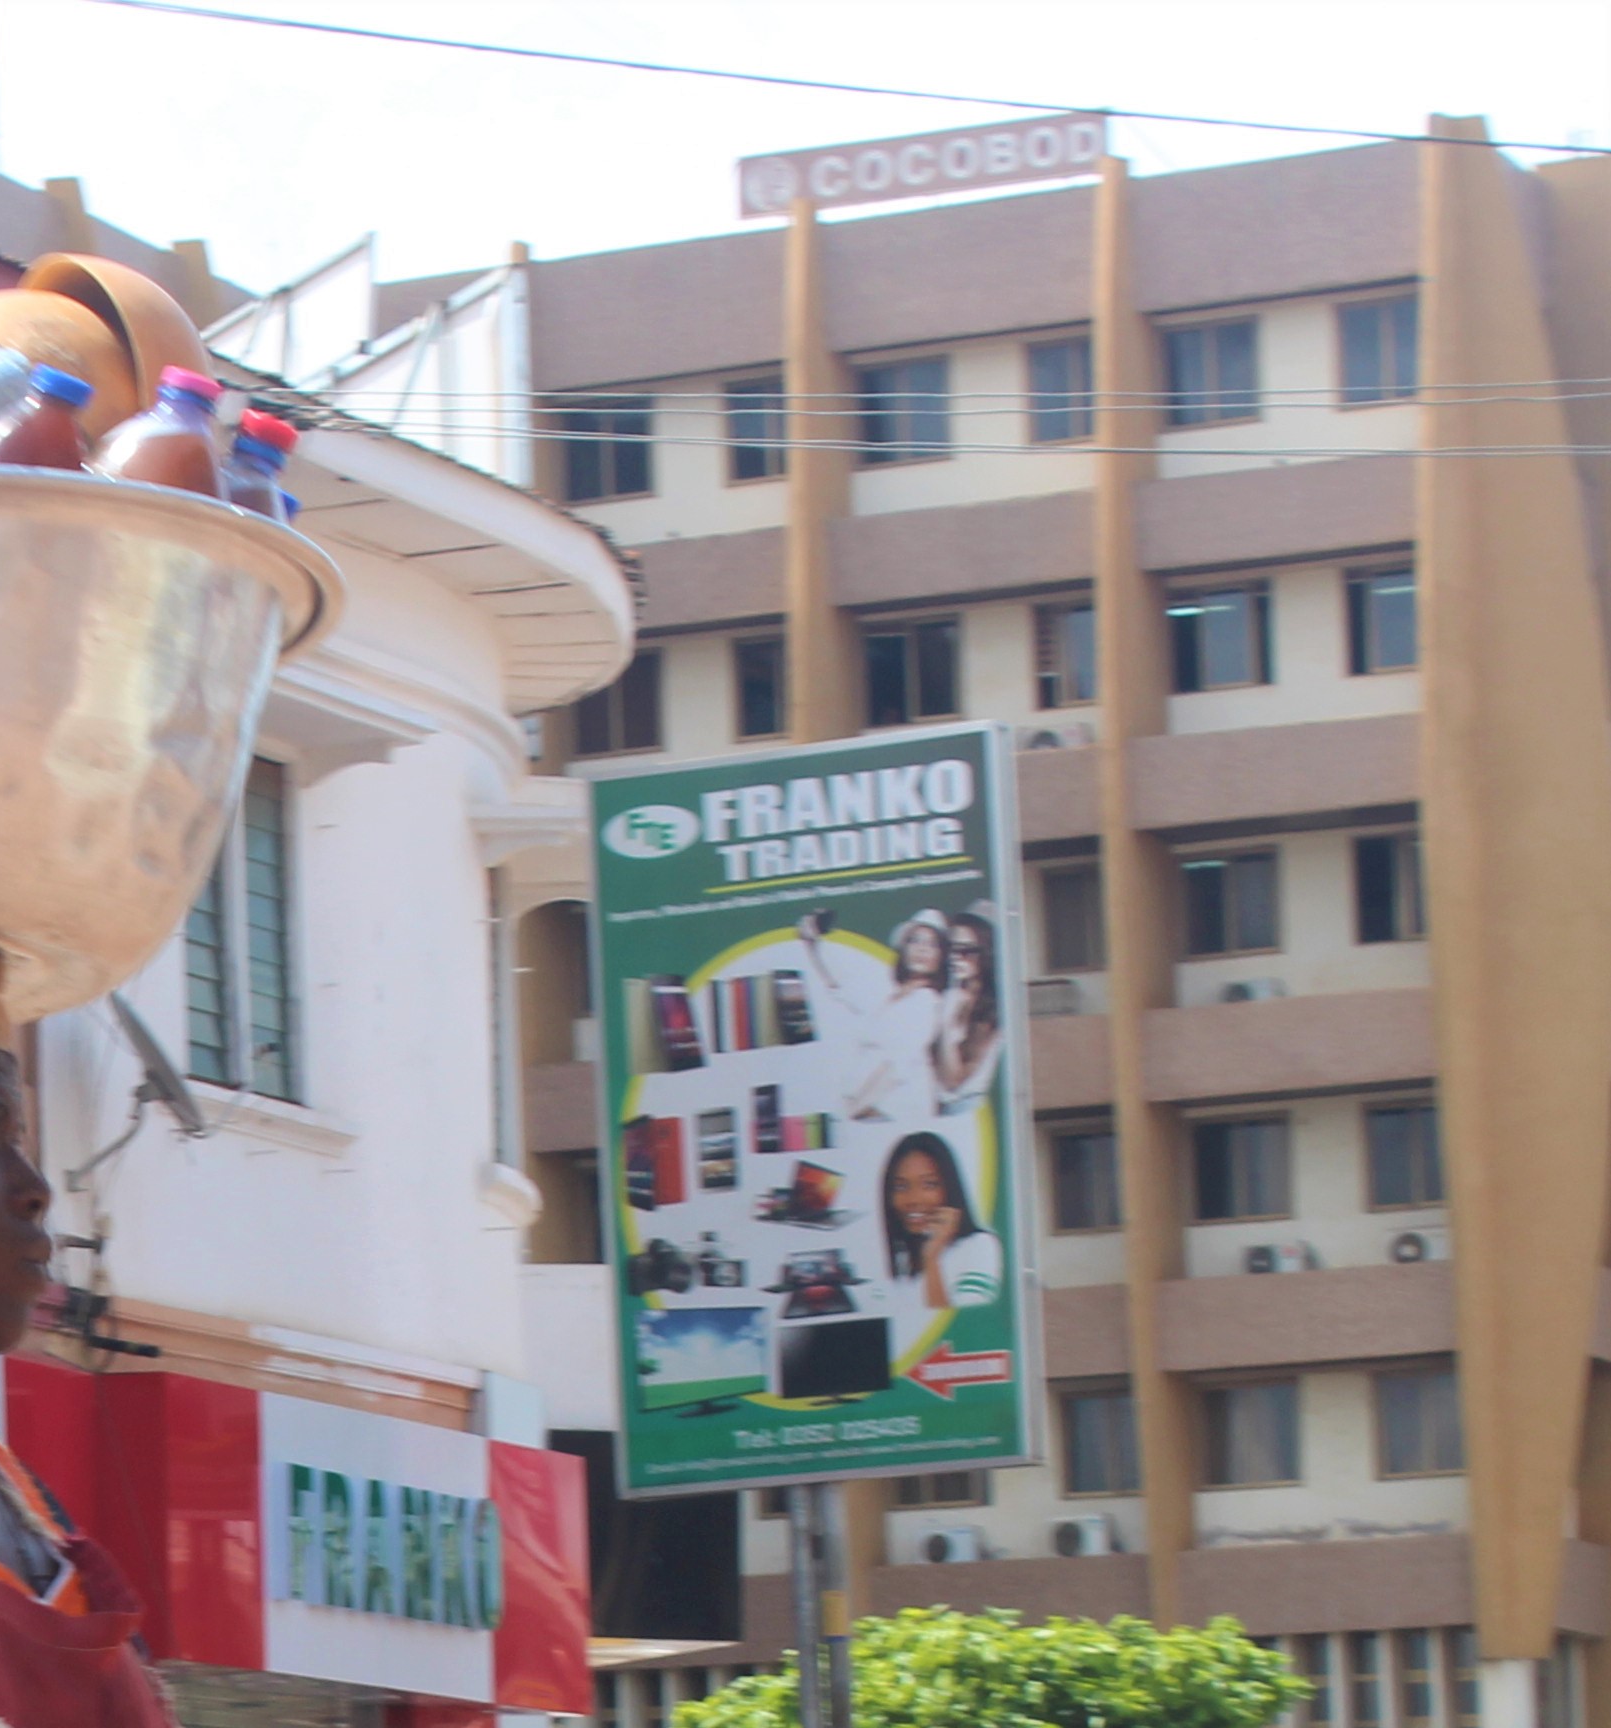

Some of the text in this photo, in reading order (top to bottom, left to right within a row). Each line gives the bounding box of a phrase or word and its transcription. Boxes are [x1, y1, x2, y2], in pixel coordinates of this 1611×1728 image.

[809, 120, 1102, 198] COCOBOD
[700, 758, 975, 843] FRANKO
[715, 817, 965, 882] TRADING
[289, 1463, 501, 1631] FRANKO
